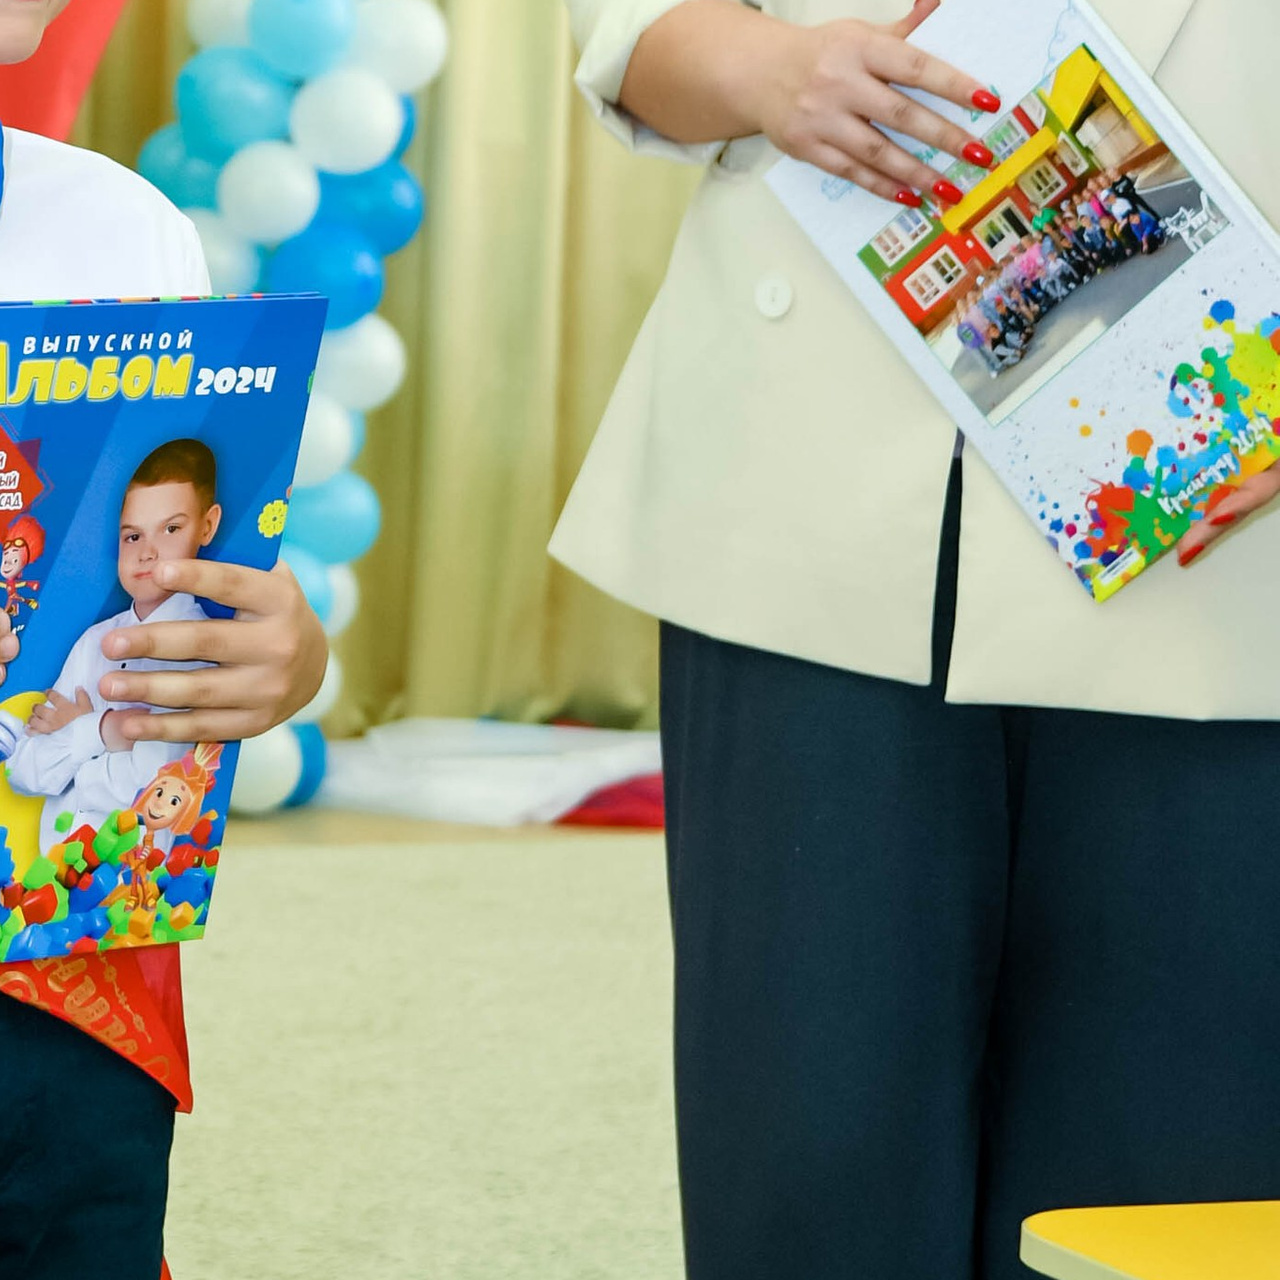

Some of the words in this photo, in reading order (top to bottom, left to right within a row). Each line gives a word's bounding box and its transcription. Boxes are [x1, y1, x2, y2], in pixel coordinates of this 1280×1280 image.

[22, 329, 193, 355] ВЫПУСКНОЙ
[194, 366, 277, 396] 2024
[1230, 416, 1273, 455] 2024
